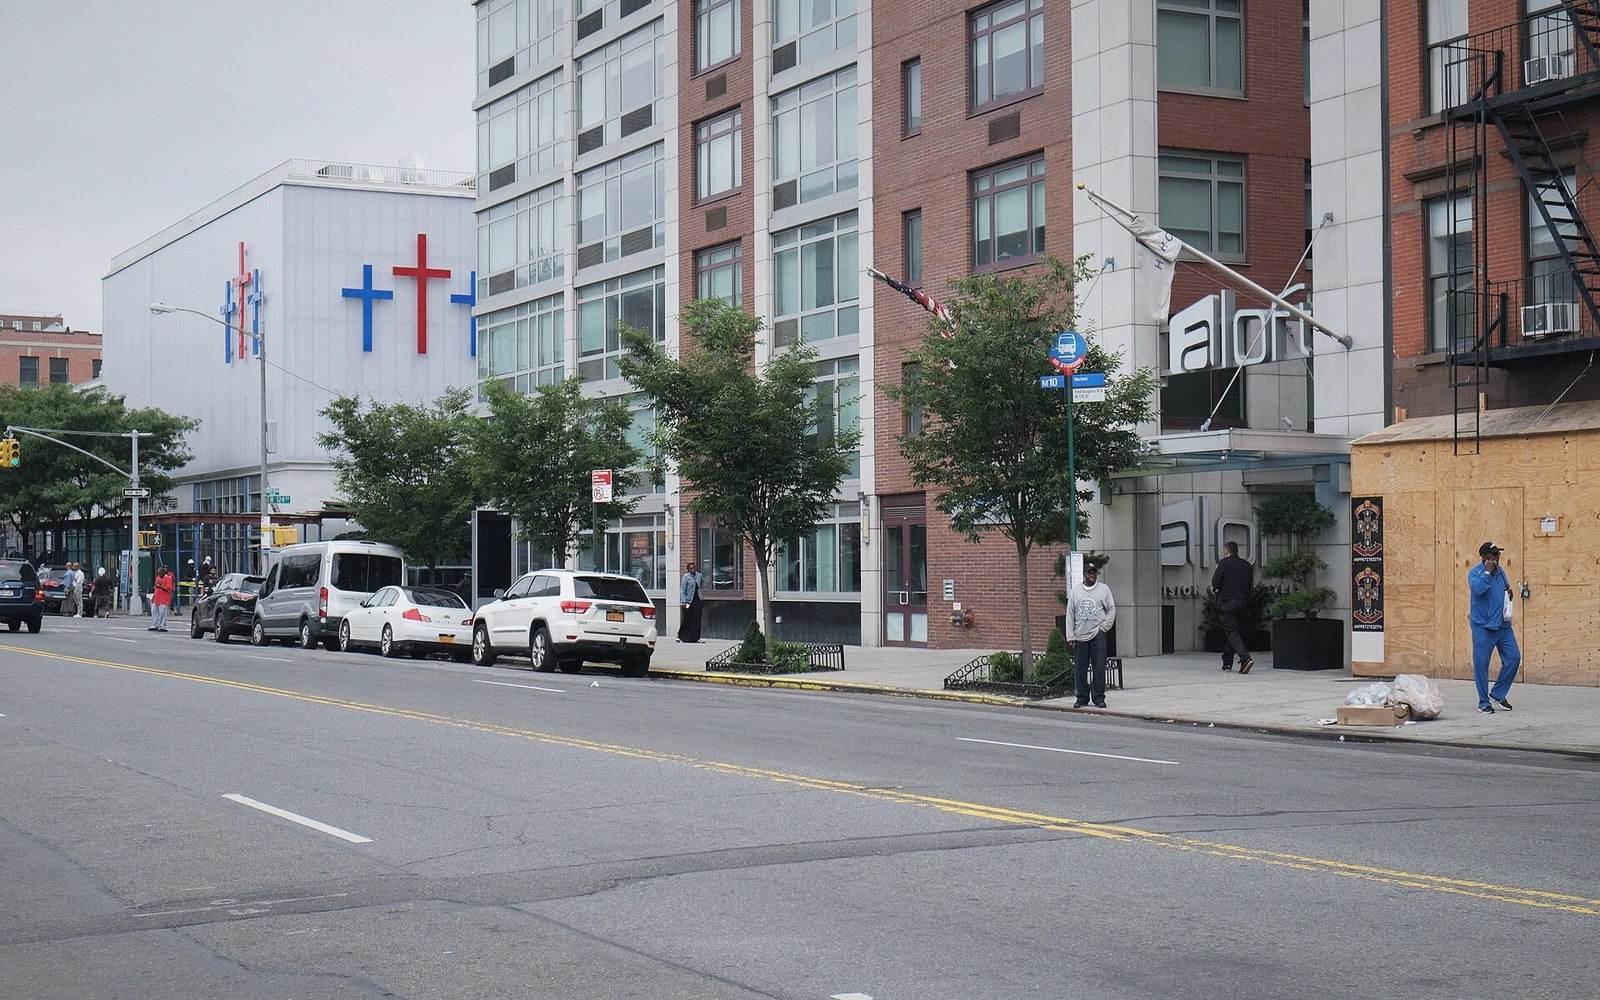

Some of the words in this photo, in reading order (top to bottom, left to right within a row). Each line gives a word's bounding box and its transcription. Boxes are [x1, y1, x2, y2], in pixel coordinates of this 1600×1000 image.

[1169, 283, 1313, 374] aloft
[1060, 357, 1083, 368] STANDING
[1042, 378, 1058, 387] M10
